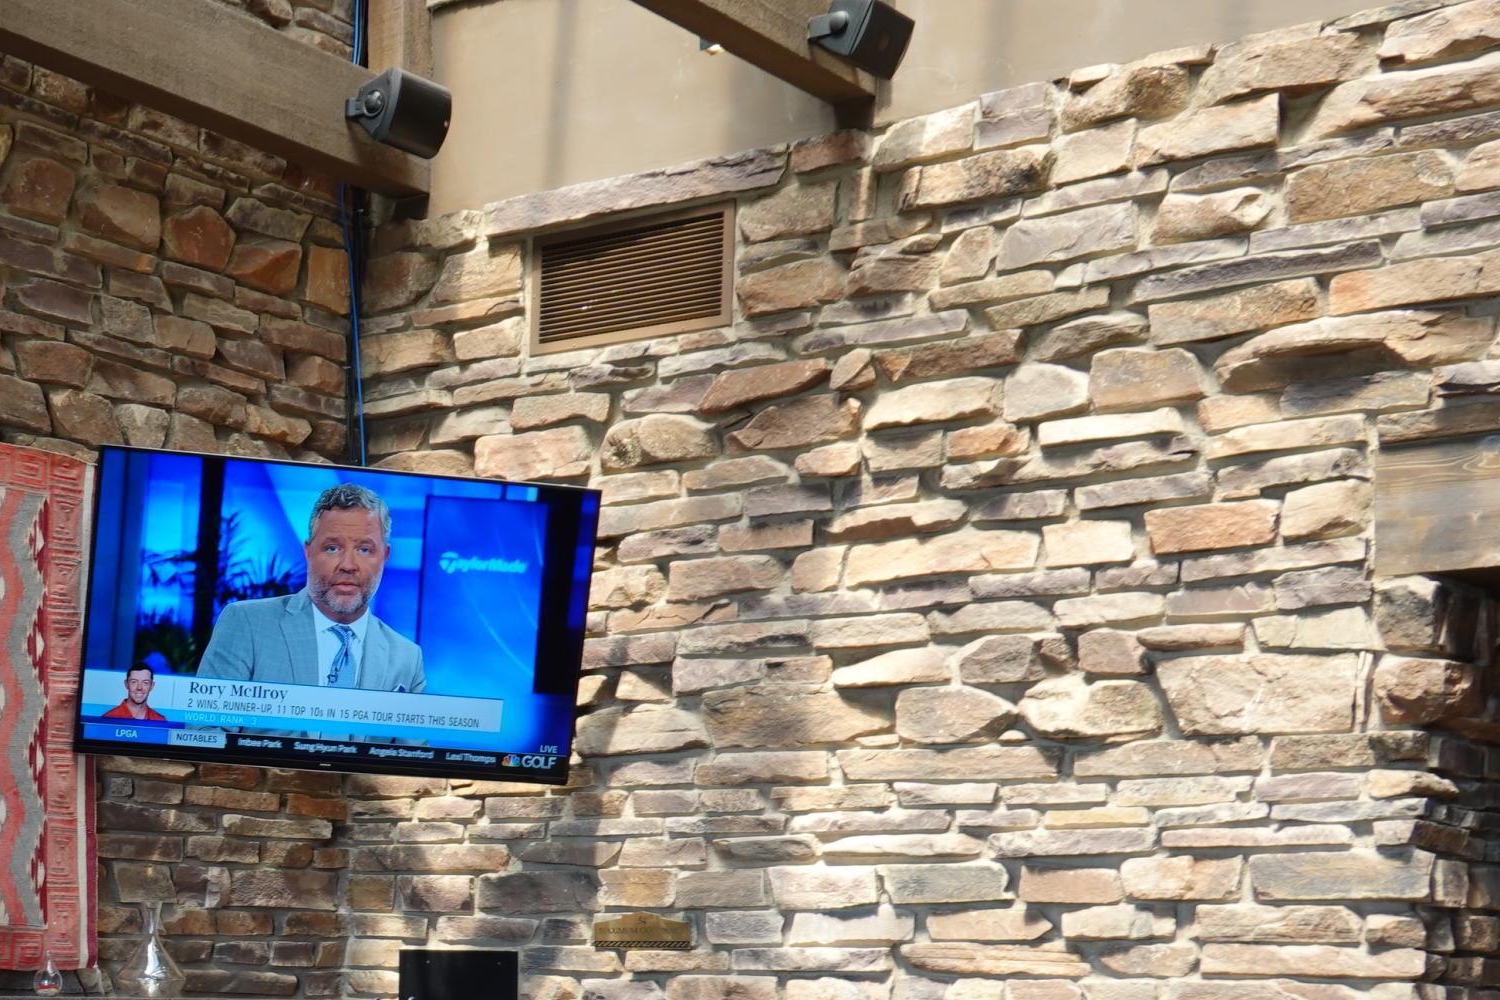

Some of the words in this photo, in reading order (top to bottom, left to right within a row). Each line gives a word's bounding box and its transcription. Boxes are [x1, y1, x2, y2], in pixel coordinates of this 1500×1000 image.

[439, 551, 528, 574] TaylorMade
[189, 681, 226, 698] Rory
[231, 684, 288, 702] McIlroy
[185, 712, 215, 722] WORLD
[187, 698, 193, 708] 2
[197, 700, 220, 711] WINS,
[223, 700, 273, 713] RUNNER-UP,
[277, 704, 286, 713] 11
[291, 705, 306, 715] TOP
[310, 707, 324, 716] 10s
[327, 708, 335, 718] IN
[340, 709, 350, 718] 15
[353, 710, 368, 721] PGA
[372, 711, 393, 722] TOUR
[396, 713, 425, 724] STARTS
[428, 715, 445, 725] THIS
[449, 717, 479, 728] SEASON
[115, 729, 137, 738] LPGA
[176, 733, 217, 743] NOTABLES
[262, 740, 282, 748] Park
[338, 745, 357, 753] Park
[540, 745, 558, 753] LIVE
[522, 756, 557, 769] GOLF
